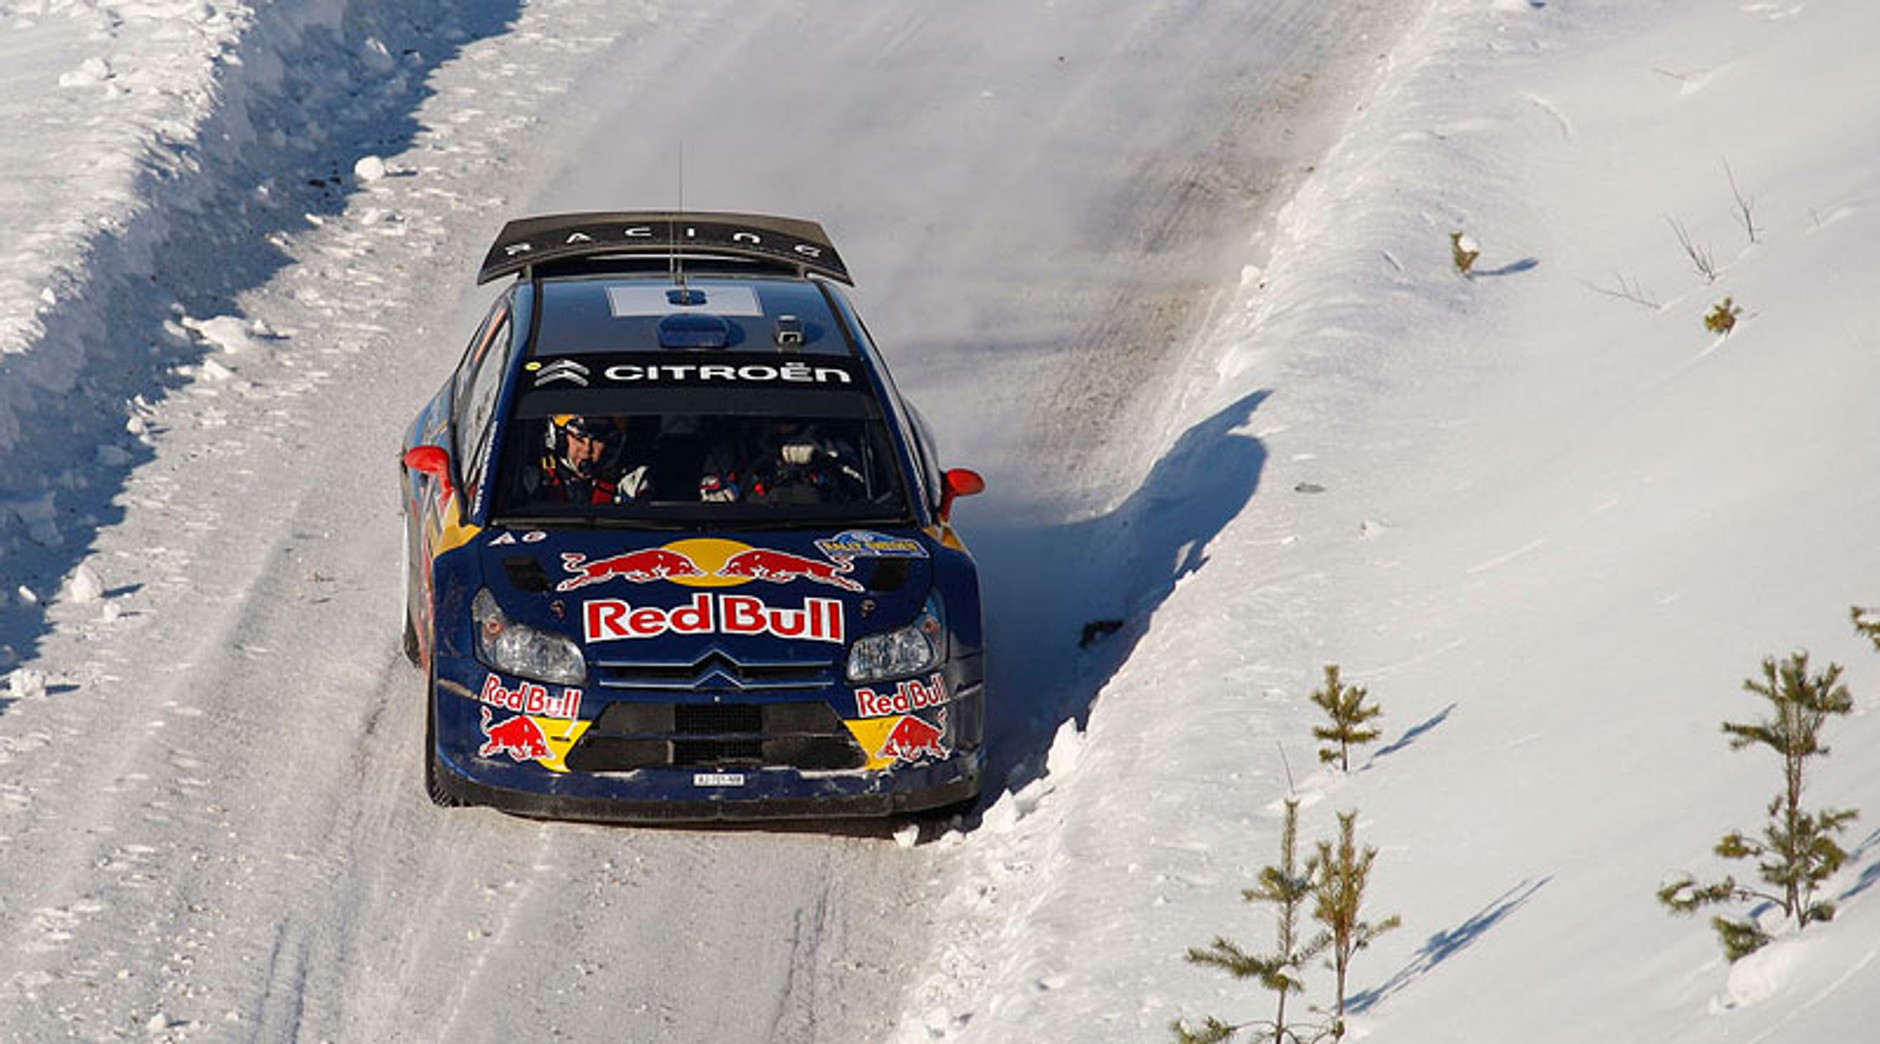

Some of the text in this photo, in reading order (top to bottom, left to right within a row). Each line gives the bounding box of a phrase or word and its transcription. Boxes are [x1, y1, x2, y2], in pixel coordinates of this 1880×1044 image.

[584, 593, 844, 644] Red Bull
[481, 673, 581, 717] Red Bull
[855, 673, 949, 717] Red Bull
